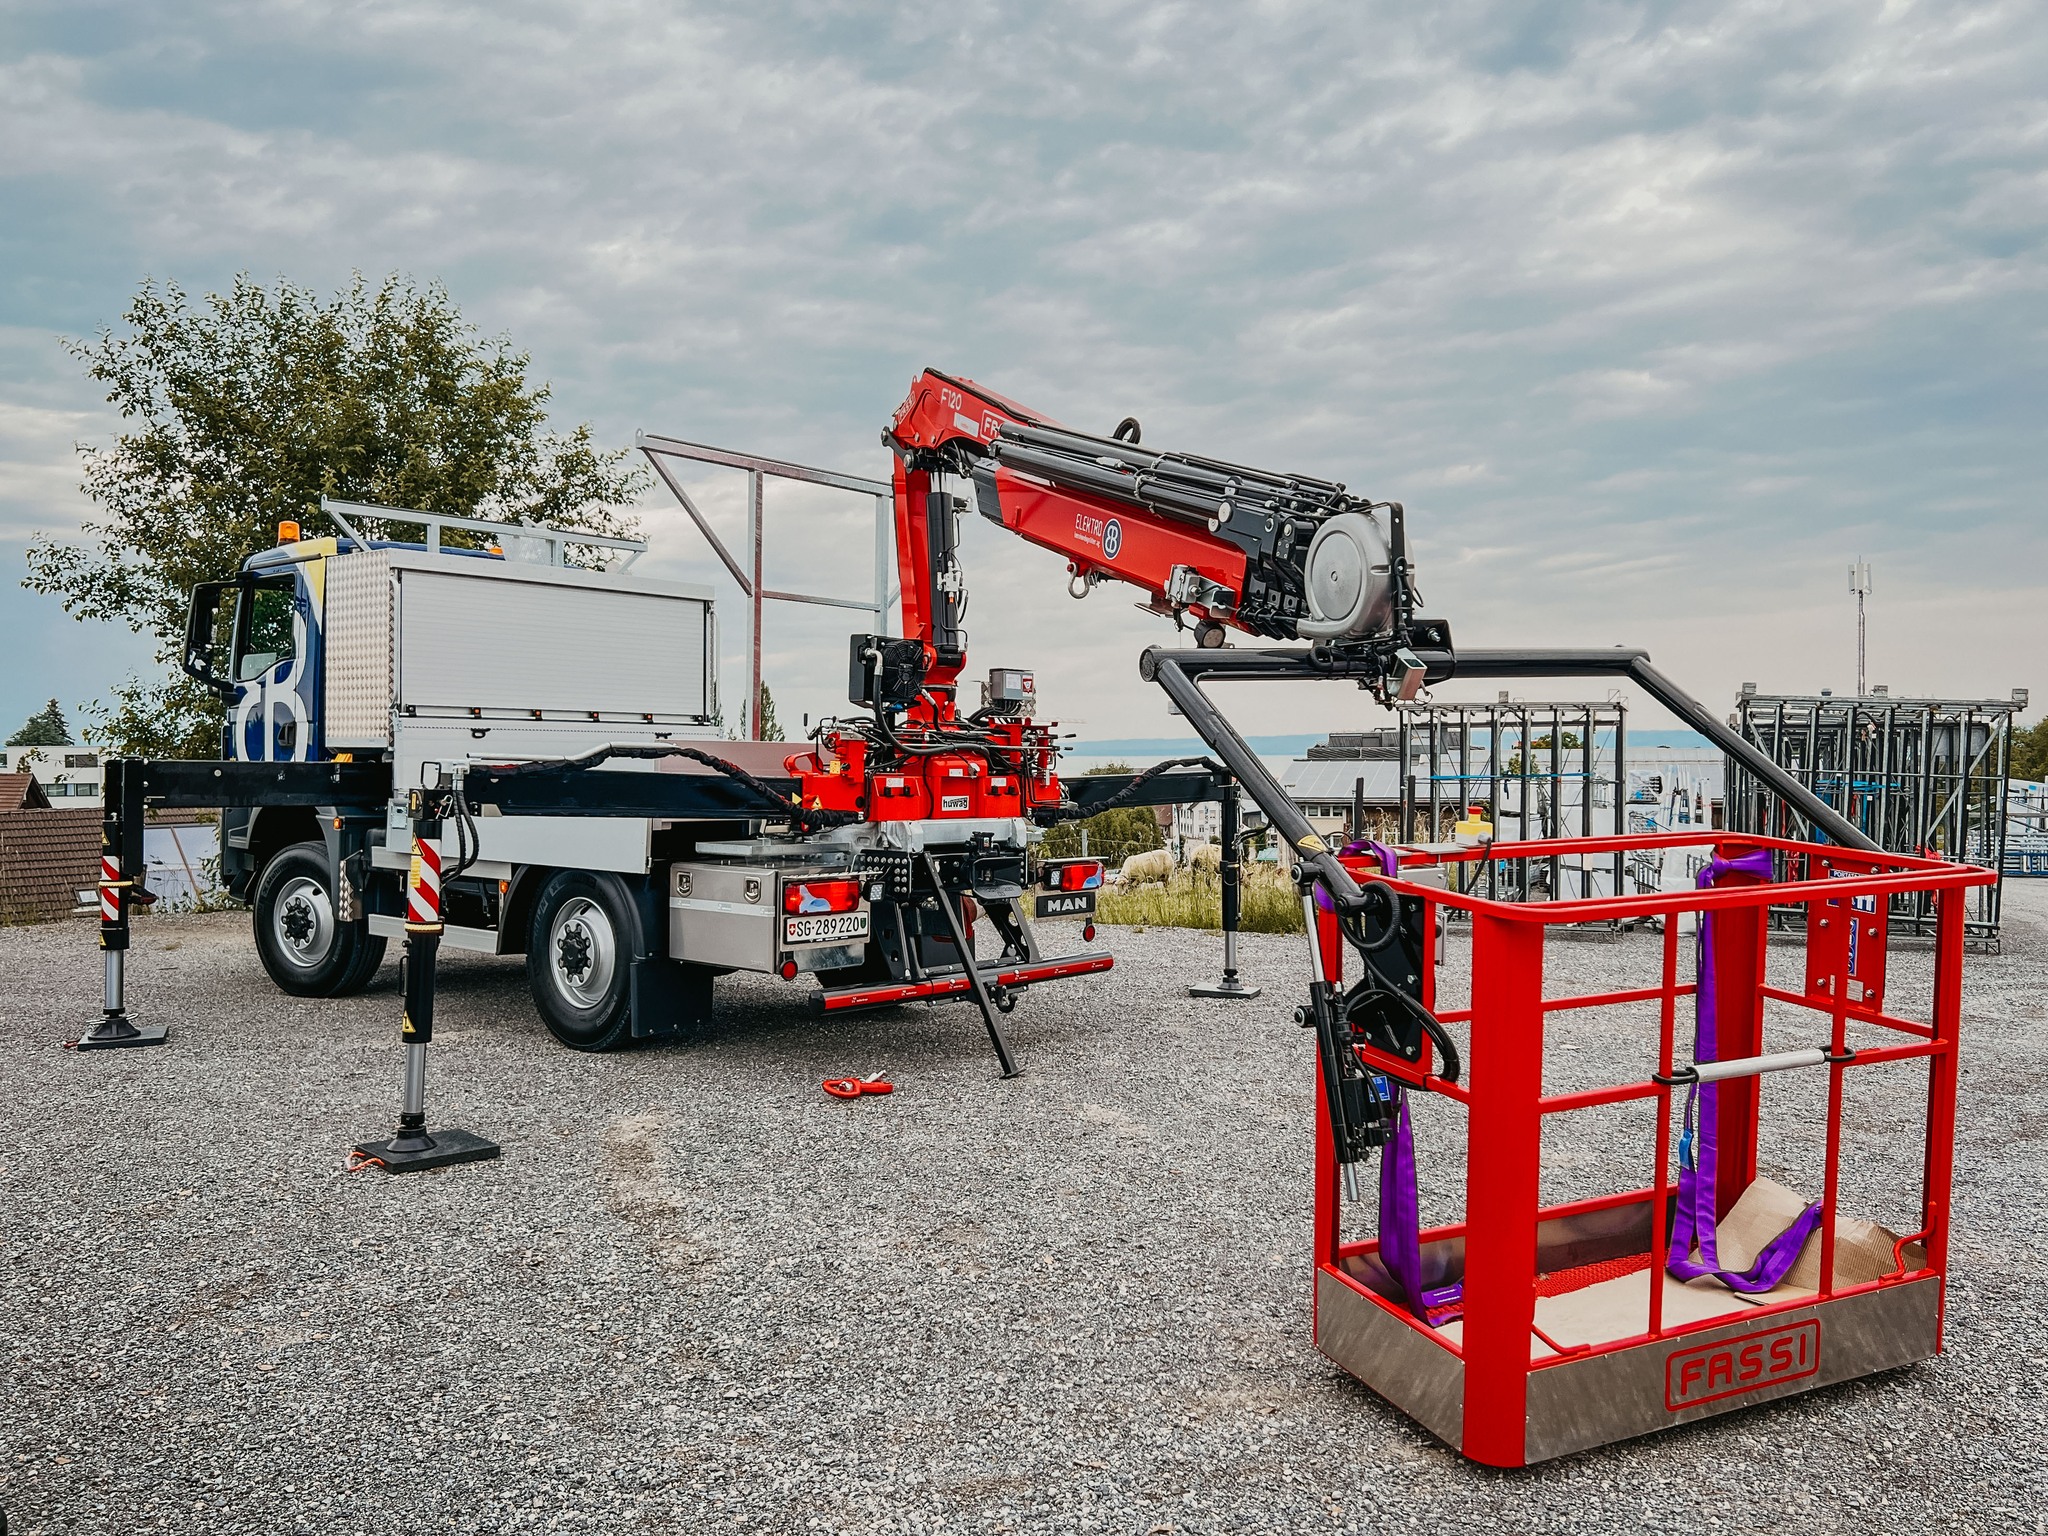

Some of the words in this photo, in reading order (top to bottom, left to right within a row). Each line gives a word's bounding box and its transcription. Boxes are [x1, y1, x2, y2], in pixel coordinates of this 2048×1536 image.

[941, 387, 962, 411] F120
[1075, 513, 1103, 537] ELEKTRO
[1047, 896, 1087, 912] MAN
[1680, 1333, 1806, 1396] FASSI
